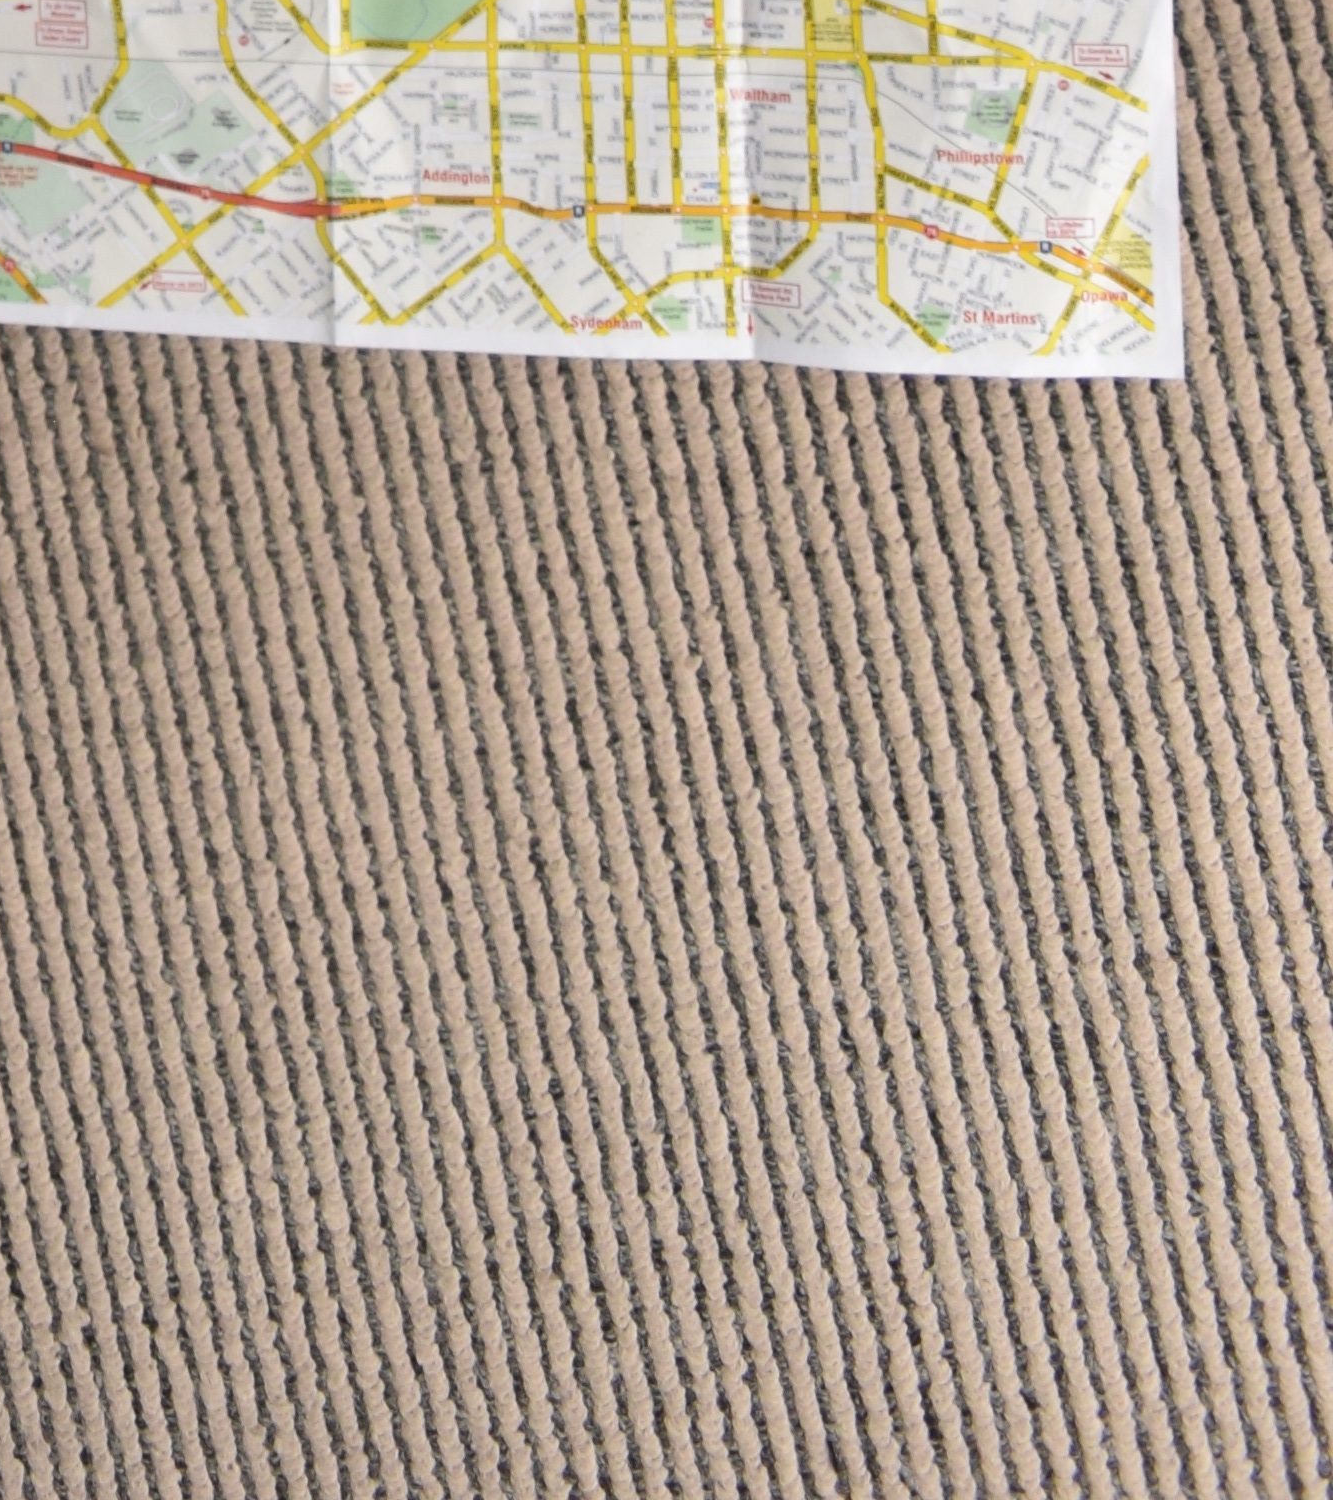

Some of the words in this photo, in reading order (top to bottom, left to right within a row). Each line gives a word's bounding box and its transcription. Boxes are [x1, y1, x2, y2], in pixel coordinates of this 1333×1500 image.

[730, 89, 792, 105] Waltham
[936, 149, 1027, 168] Phillipstown
[422, 168, 492, 186] Addington
[1080, 288, 1130, 305] Opawa
[570, 316, 644, 334] Sydenham
[963, 310, 979, 327] St
[982, 310, 1037, 327] Martins
